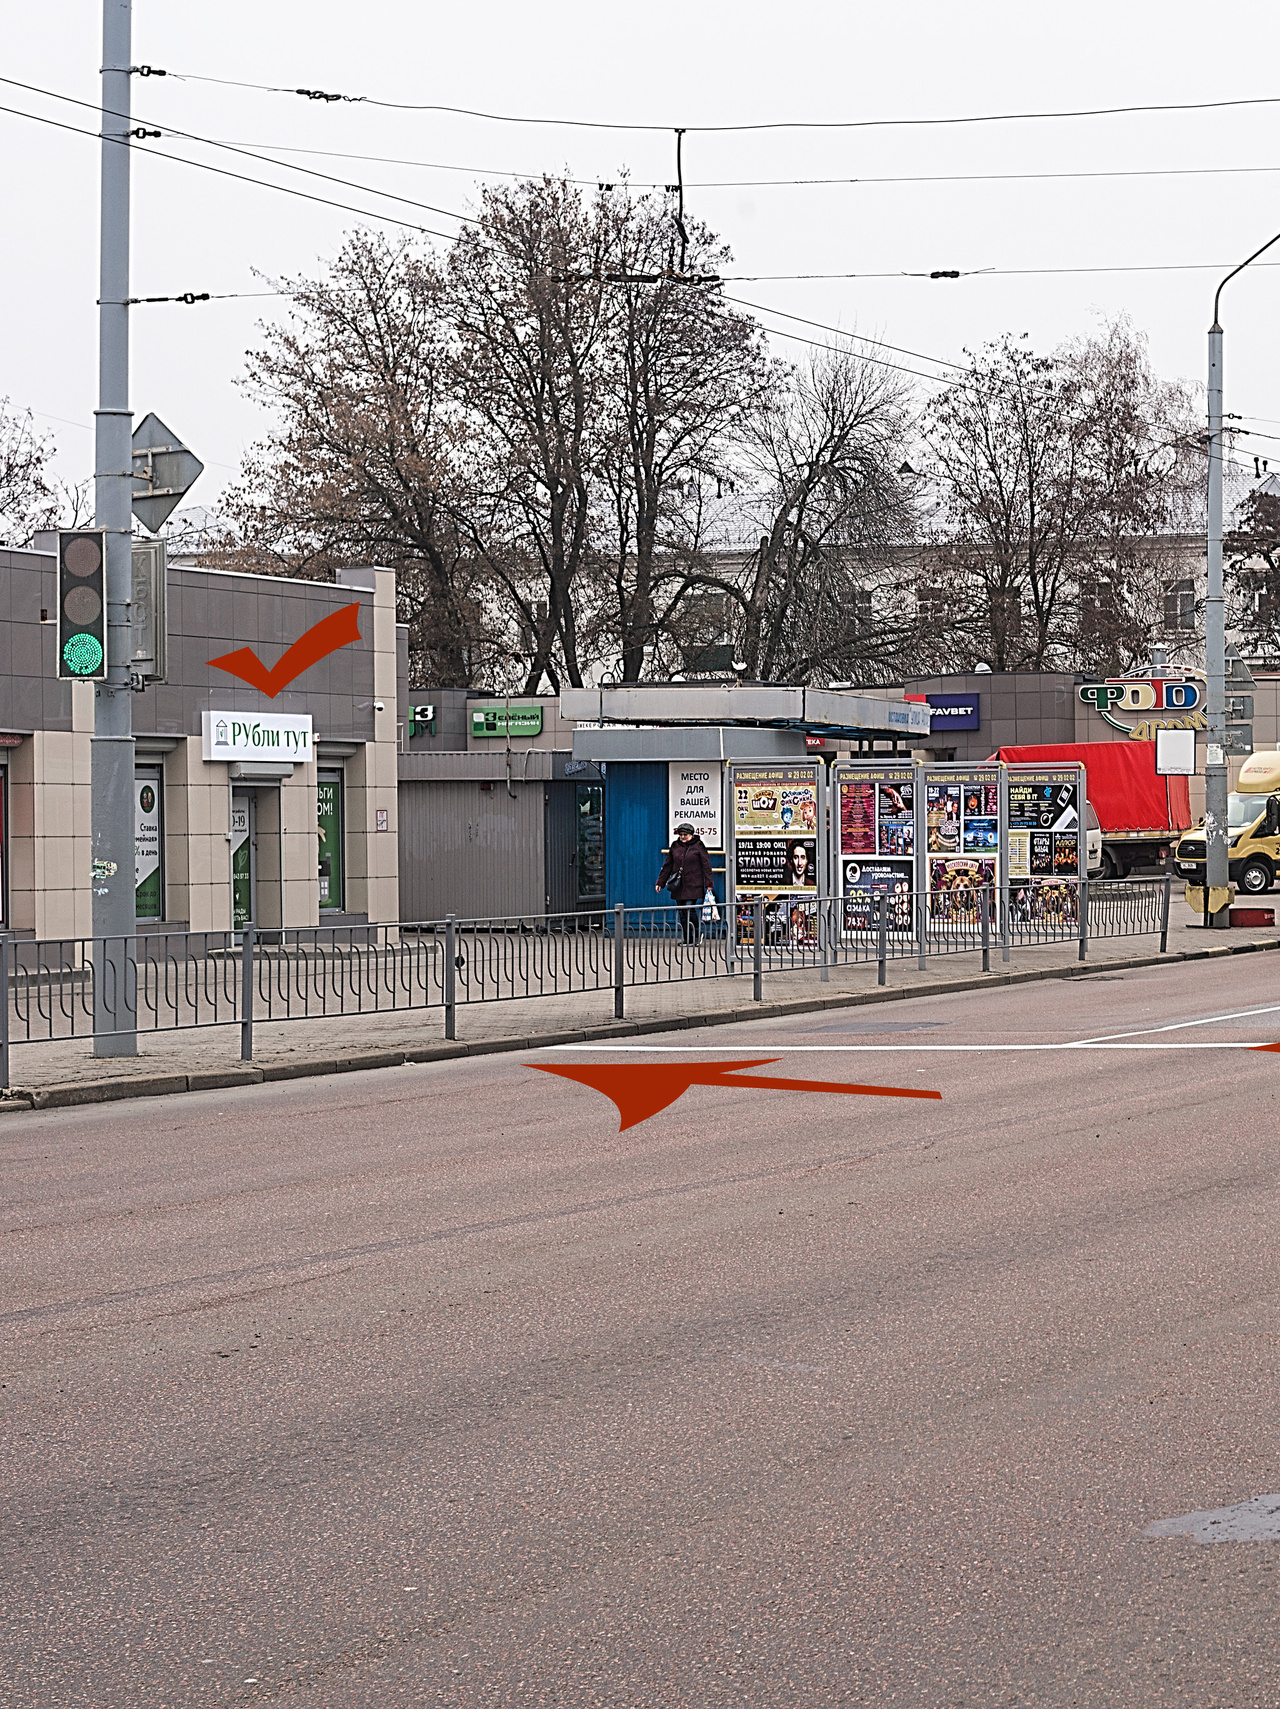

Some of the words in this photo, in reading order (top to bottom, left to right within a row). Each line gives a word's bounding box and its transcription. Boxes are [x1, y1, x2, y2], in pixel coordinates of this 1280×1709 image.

[1079, 678, 1200, 711] ФОТО
[930, 707, 974, 716] FAVBET
[284, 730, 309, 755] тут
[681, 773, 710, 781] МЕСТО
[686, 785, 704, 795] ДЛЯ
[1010, 786, 1033, 794] НАЙДИ
[680, 796, 710, 806] ВАШЕЙ
[674, 810, 716, 819] РЕКЛАМЫ
[140, 823, 157, 831] Ставка
[738, 841, 753, 849] 19/11
[756, 841, 771, 849] 19:00
[738, 857, 771, 867] STAND
[773, 857, 786, 867] UP
